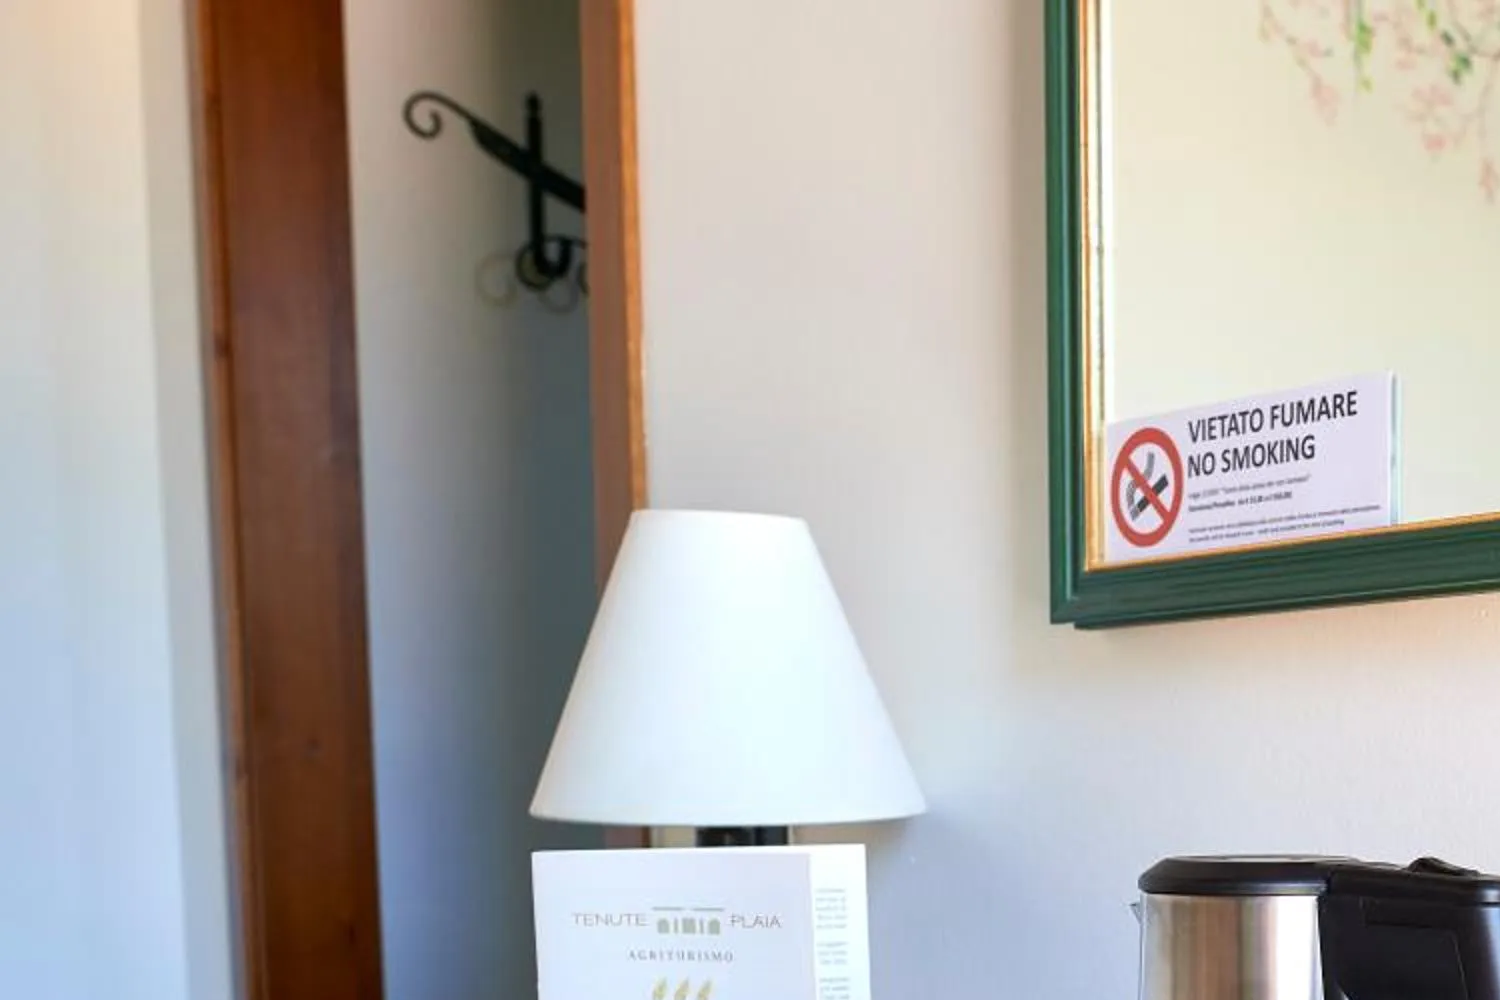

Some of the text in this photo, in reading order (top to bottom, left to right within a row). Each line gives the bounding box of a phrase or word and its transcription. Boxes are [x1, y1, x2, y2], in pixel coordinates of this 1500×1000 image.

[1187, 389, 1359, 444] VIETATO FUMARE
[1187, 434, 1316, 479] NO SMOKING
[572, 912, 782, 929] TENUTE PLAIA
[628, 949, 734, 962] AGRITURISMO
